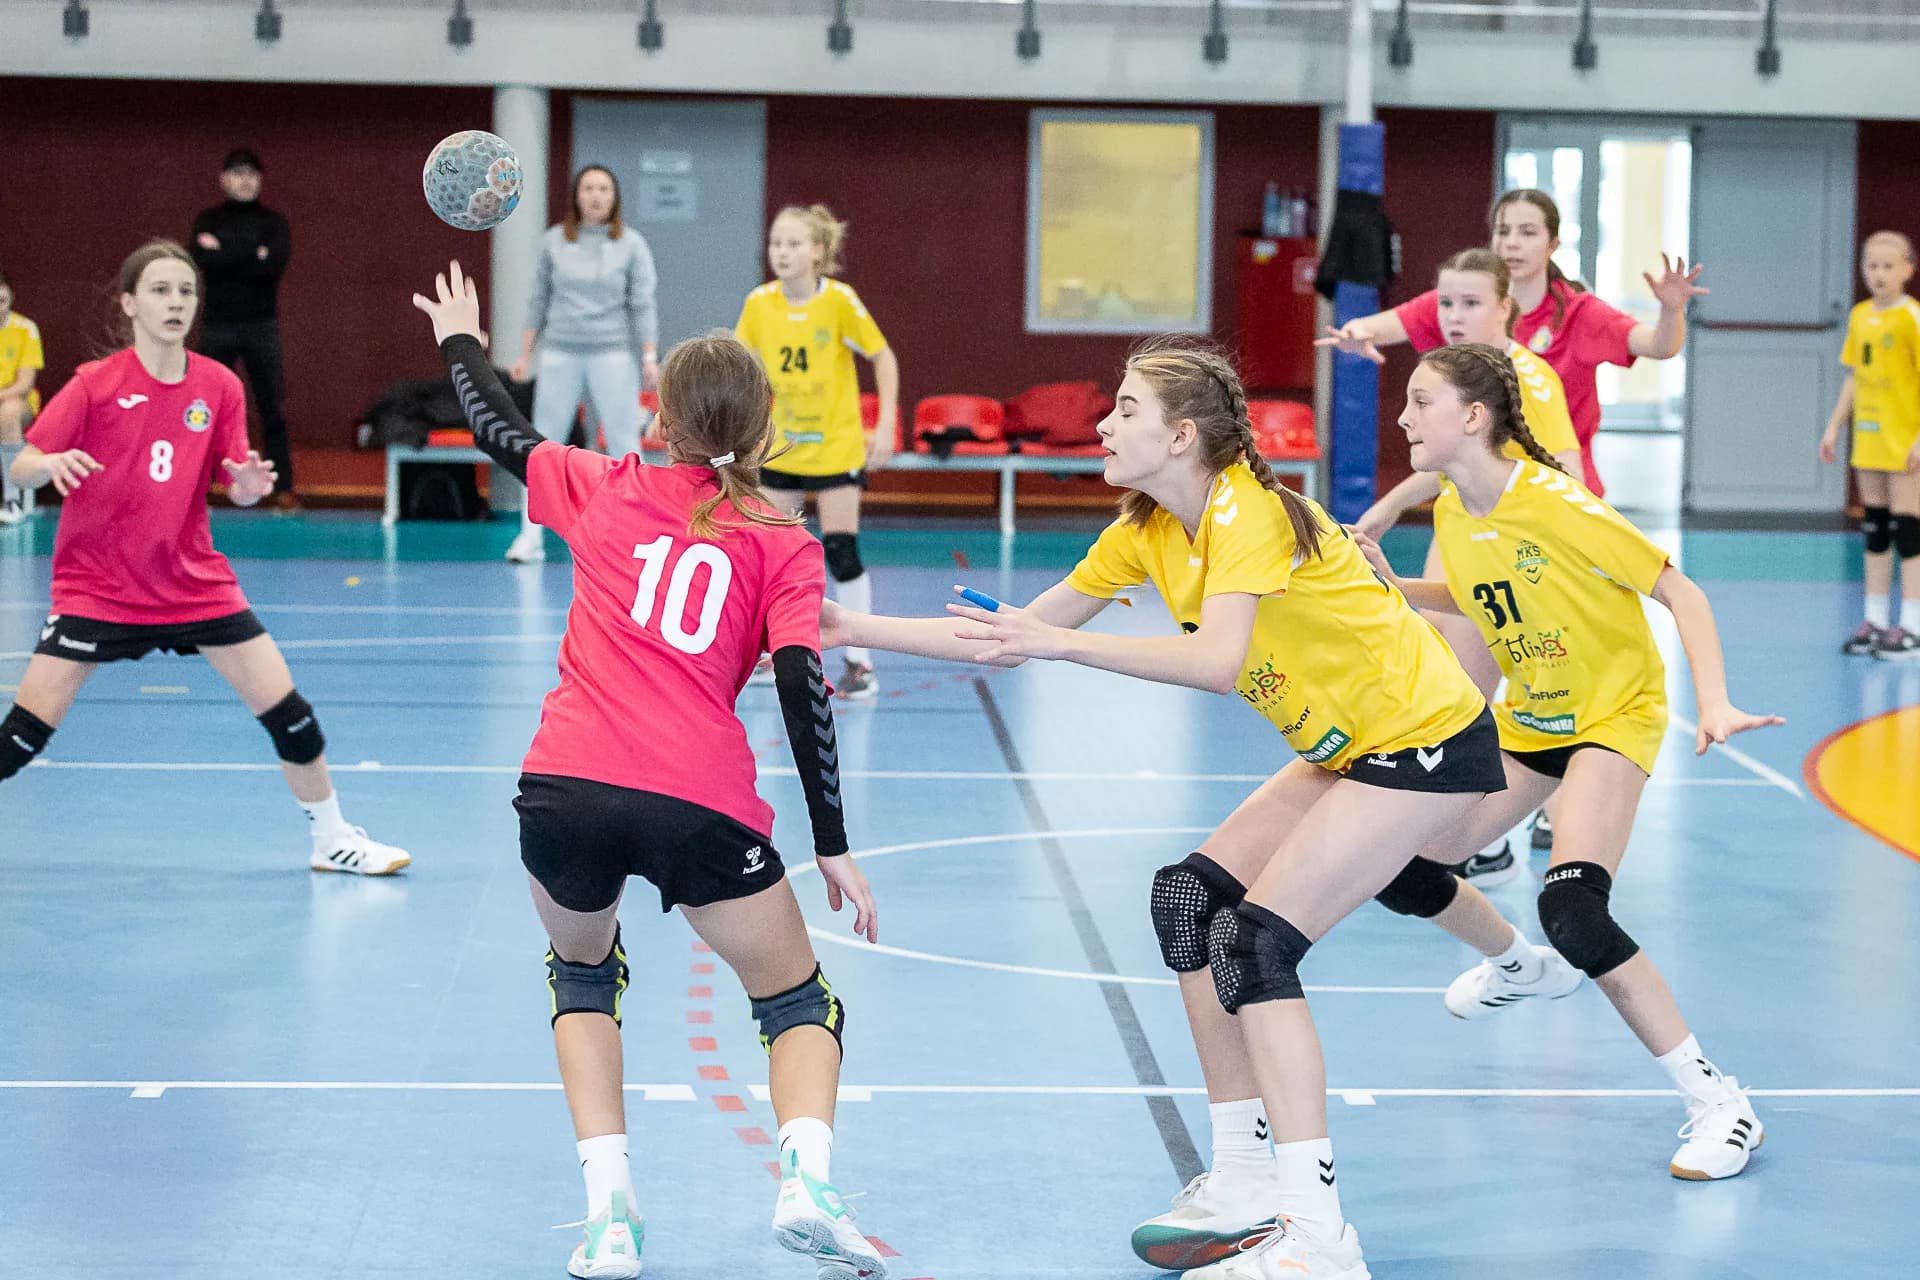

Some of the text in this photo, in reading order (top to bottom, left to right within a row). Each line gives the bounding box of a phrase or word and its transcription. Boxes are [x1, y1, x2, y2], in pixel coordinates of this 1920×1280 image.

[780, 346, 808, 373] 24
[149, 439, 174, 483] 8
[1516, 545, 1542, 560] MKS
[630, 534, 733, 655] 10
[1473, 579, 1523, 630] 37
